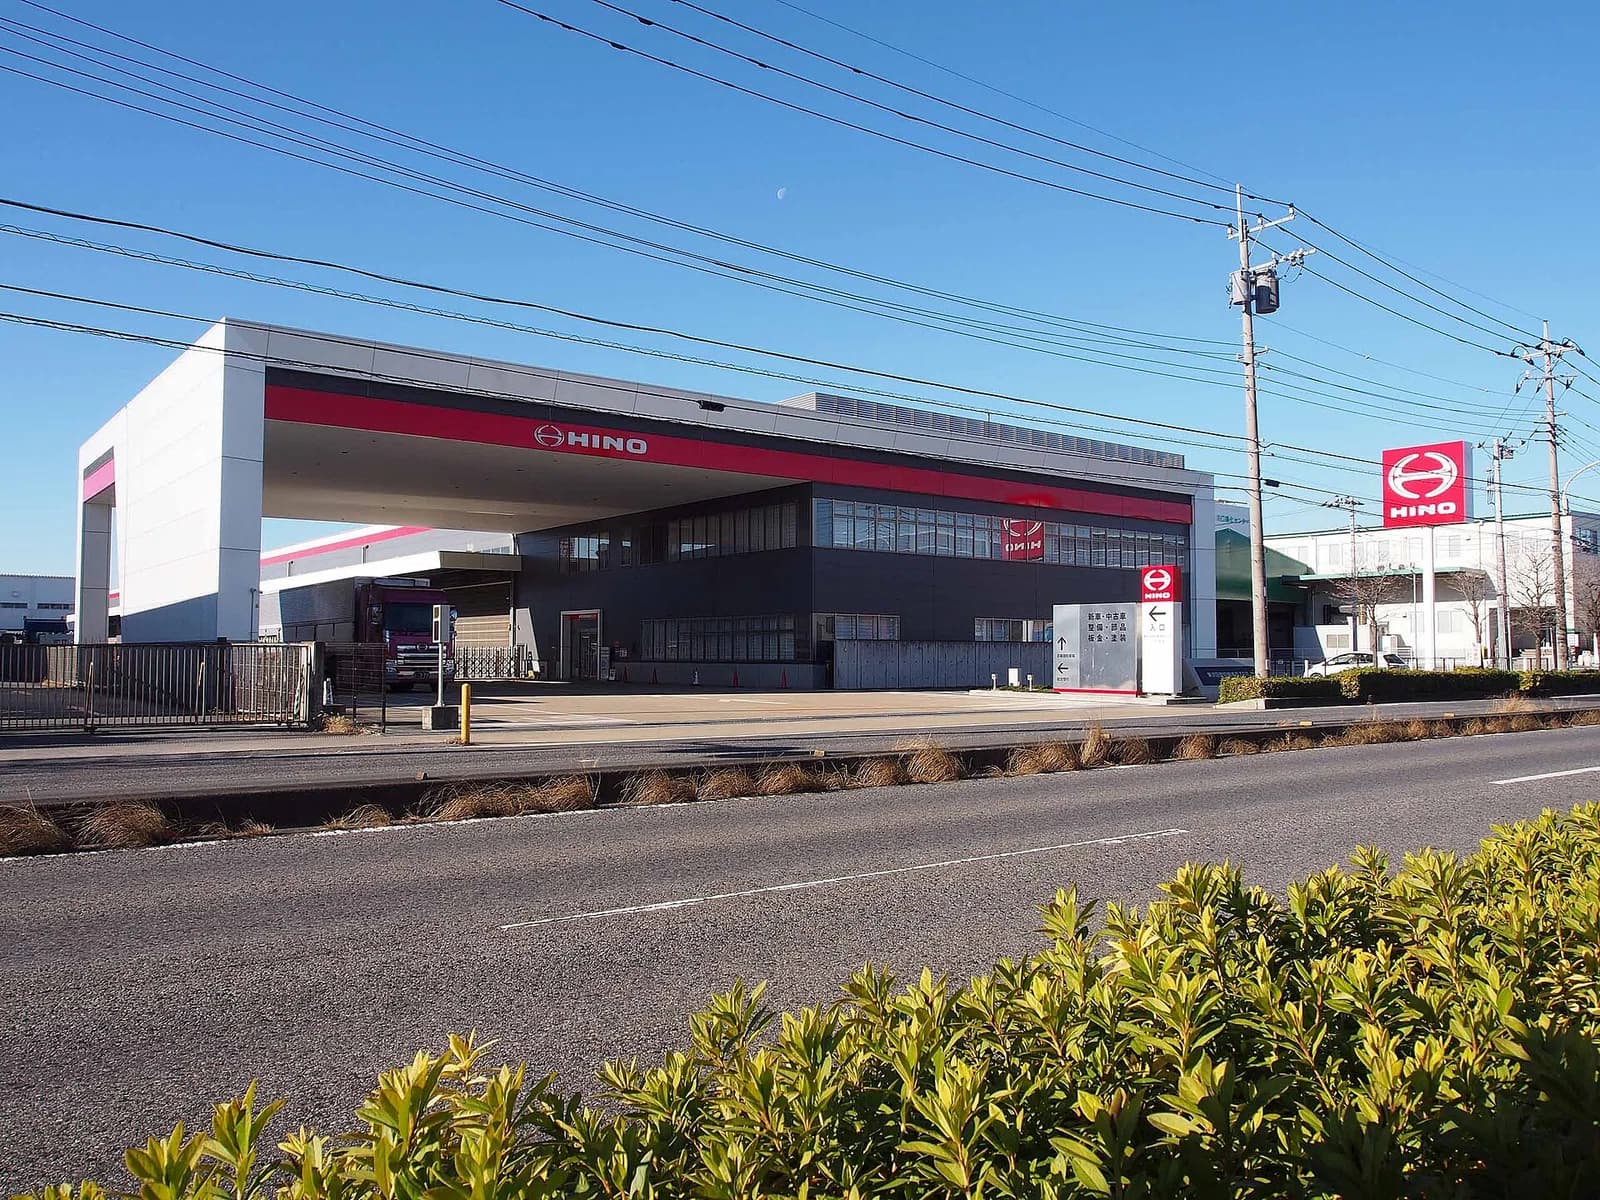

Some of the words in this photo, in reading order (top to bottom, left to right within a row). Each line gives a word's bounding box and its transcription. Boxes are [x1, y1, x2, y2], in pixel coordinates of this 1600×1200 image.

[567, 431, 648, 455] HINO
[1390, 501, 1457, 519] HINO
[1144, 591, 1171, 600] HINO
[1088, 612, 1127, 621] 新車・中古車
[1149, 623, 1166, 632] 入口
